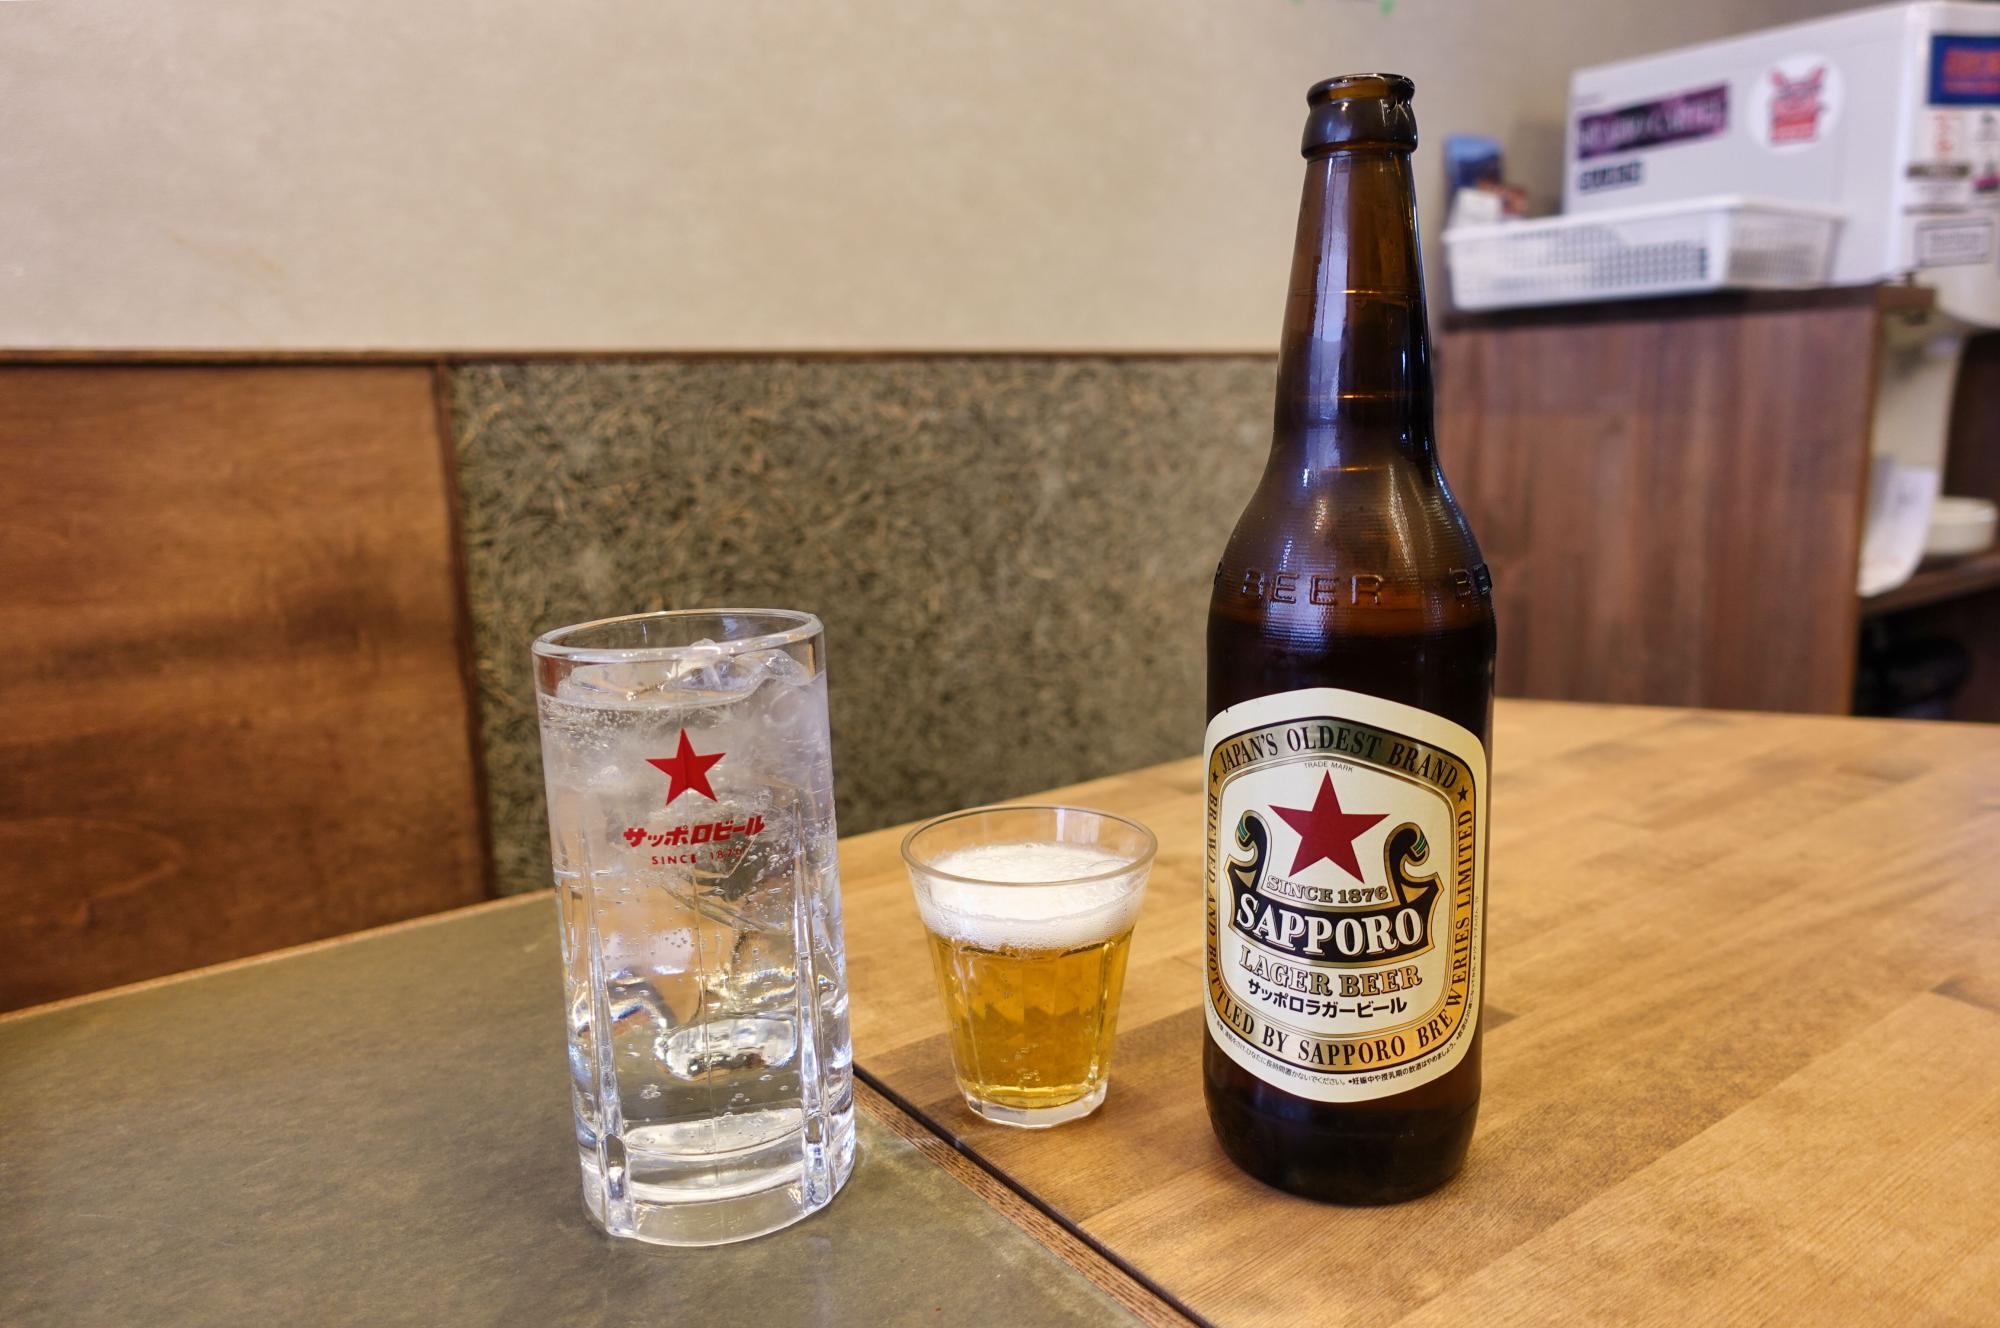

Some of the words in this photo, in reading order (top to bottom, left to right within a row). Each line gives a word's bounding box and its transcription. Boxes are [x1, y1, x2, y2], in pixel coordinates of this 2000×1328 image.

[1219, 733, 1279, 775] JAPAN'S
[1286, 725, 1383, 760] OLDEST
[1388, 742, 1459, 790] BRAND
[1304, 761, 1328, 769] TRADE
[1330, 761, 1354, 773] MARK
[623, 815, 766, 848] サッポロビール
[1208, 791, 1218, 884] BREWED
[1456, 809, 1473, 912] LIMITED
[1207, 889, 1217, 936] AND
[1266, 875, 1334, 904] SINCE
[1337, 885, 1389, 904] 1876
[1236, 893, 1424, 956] SAPPORO
[1208, 943, 1256, 1036] BOTTLED
[1239, 945, 1333, 997] LAGER
[1339, 965, 1422, 998] BEER
[1415, 916, 1471, 1049] BREWERIES
[1248, 978, 1408, 1019] サッポロラガービール
[1262, 1024, 1290, 1054] BY
[1297, 1035, 1406, 1067] SAPPORO
